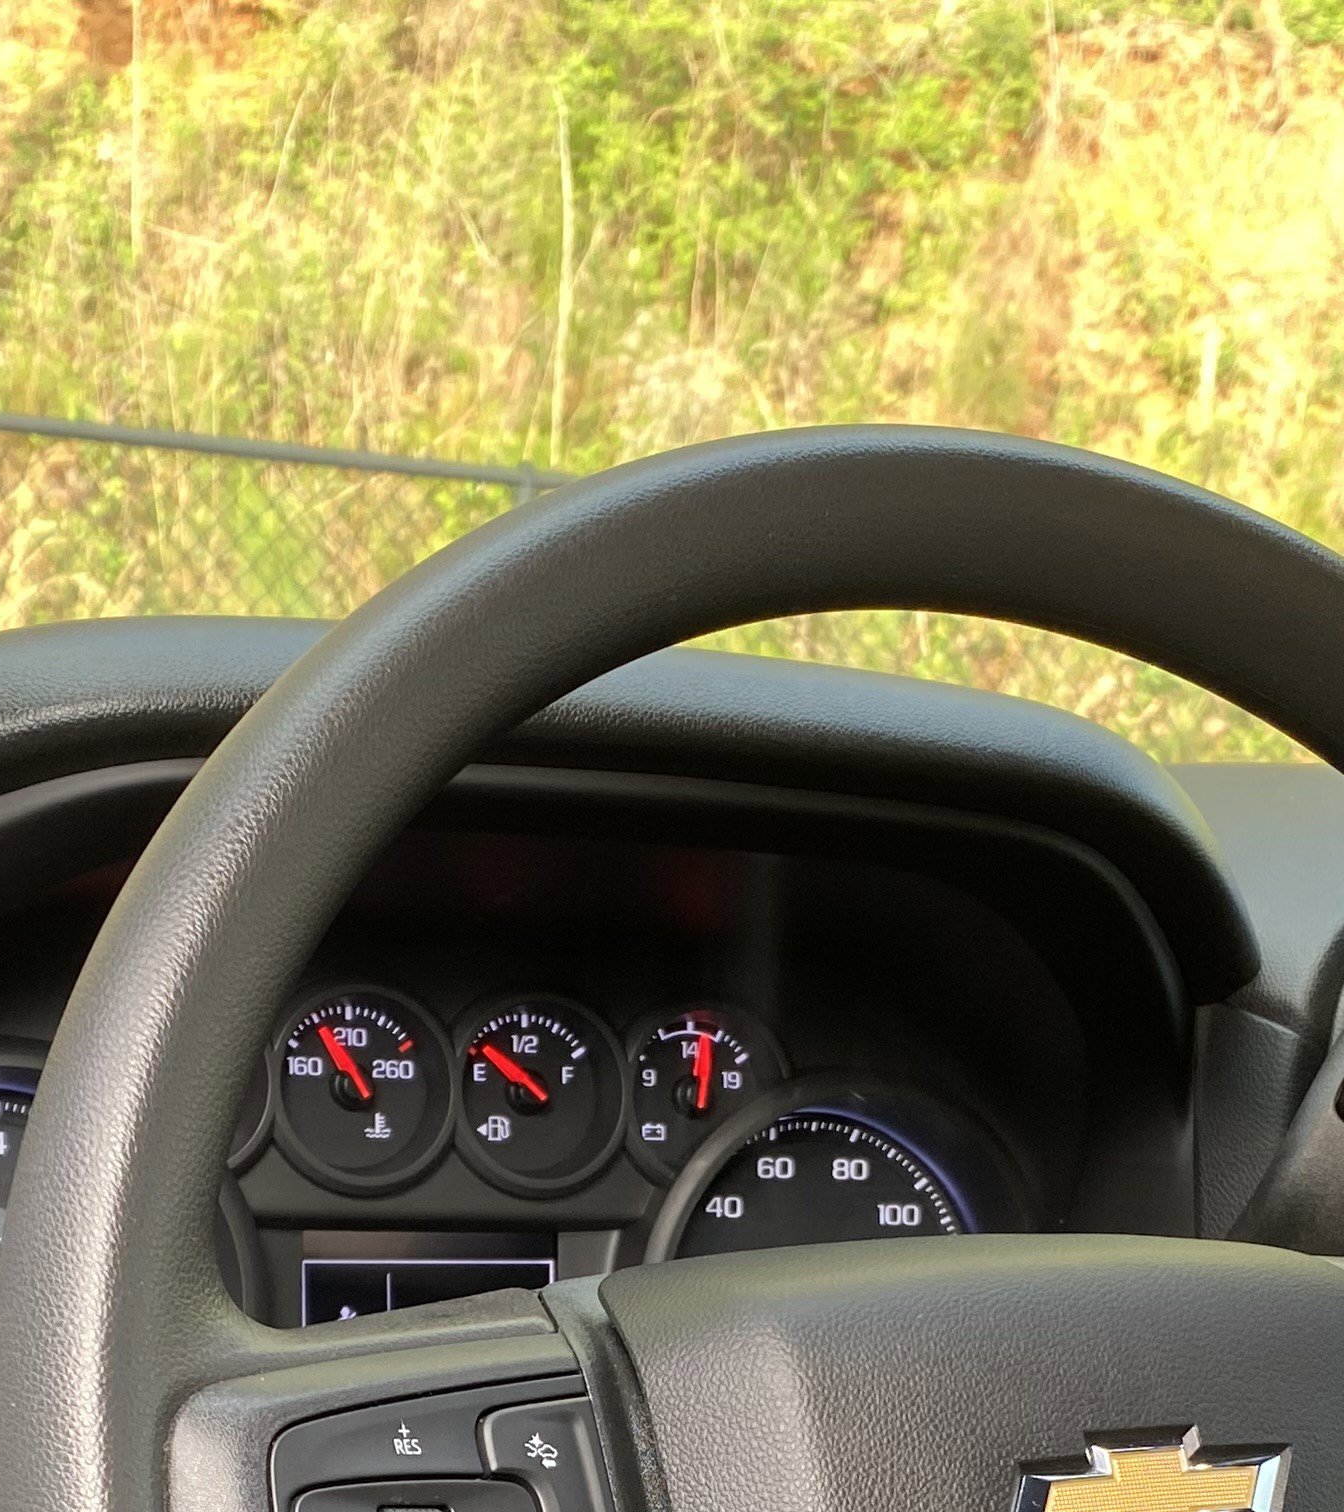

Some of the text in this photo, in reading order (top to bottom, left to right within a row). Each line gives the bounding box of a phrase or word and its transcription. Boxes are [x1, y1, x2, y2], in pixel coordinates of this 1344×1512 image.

[333, 1027, 368, 1047] 210
[511, 1034, 539, 1054] 1/2
[287, 1056, 323, 1076] 160
[372, 1059, 414, 1080] 260
[472, 1063, 487, 1082] E
[561, 1066, 575, 1085] F
[642, 1069, 657, 1087] 9
[722, 1071, 742, 1090] 19
[757, 1157, 795, 1179] 60
[832, 1158, 869, 1181] 80
[706, 1196, 743, 1218] 40
[877, 1204, 921, 1226] 100
[393, 1438, 422, 1455] RES
